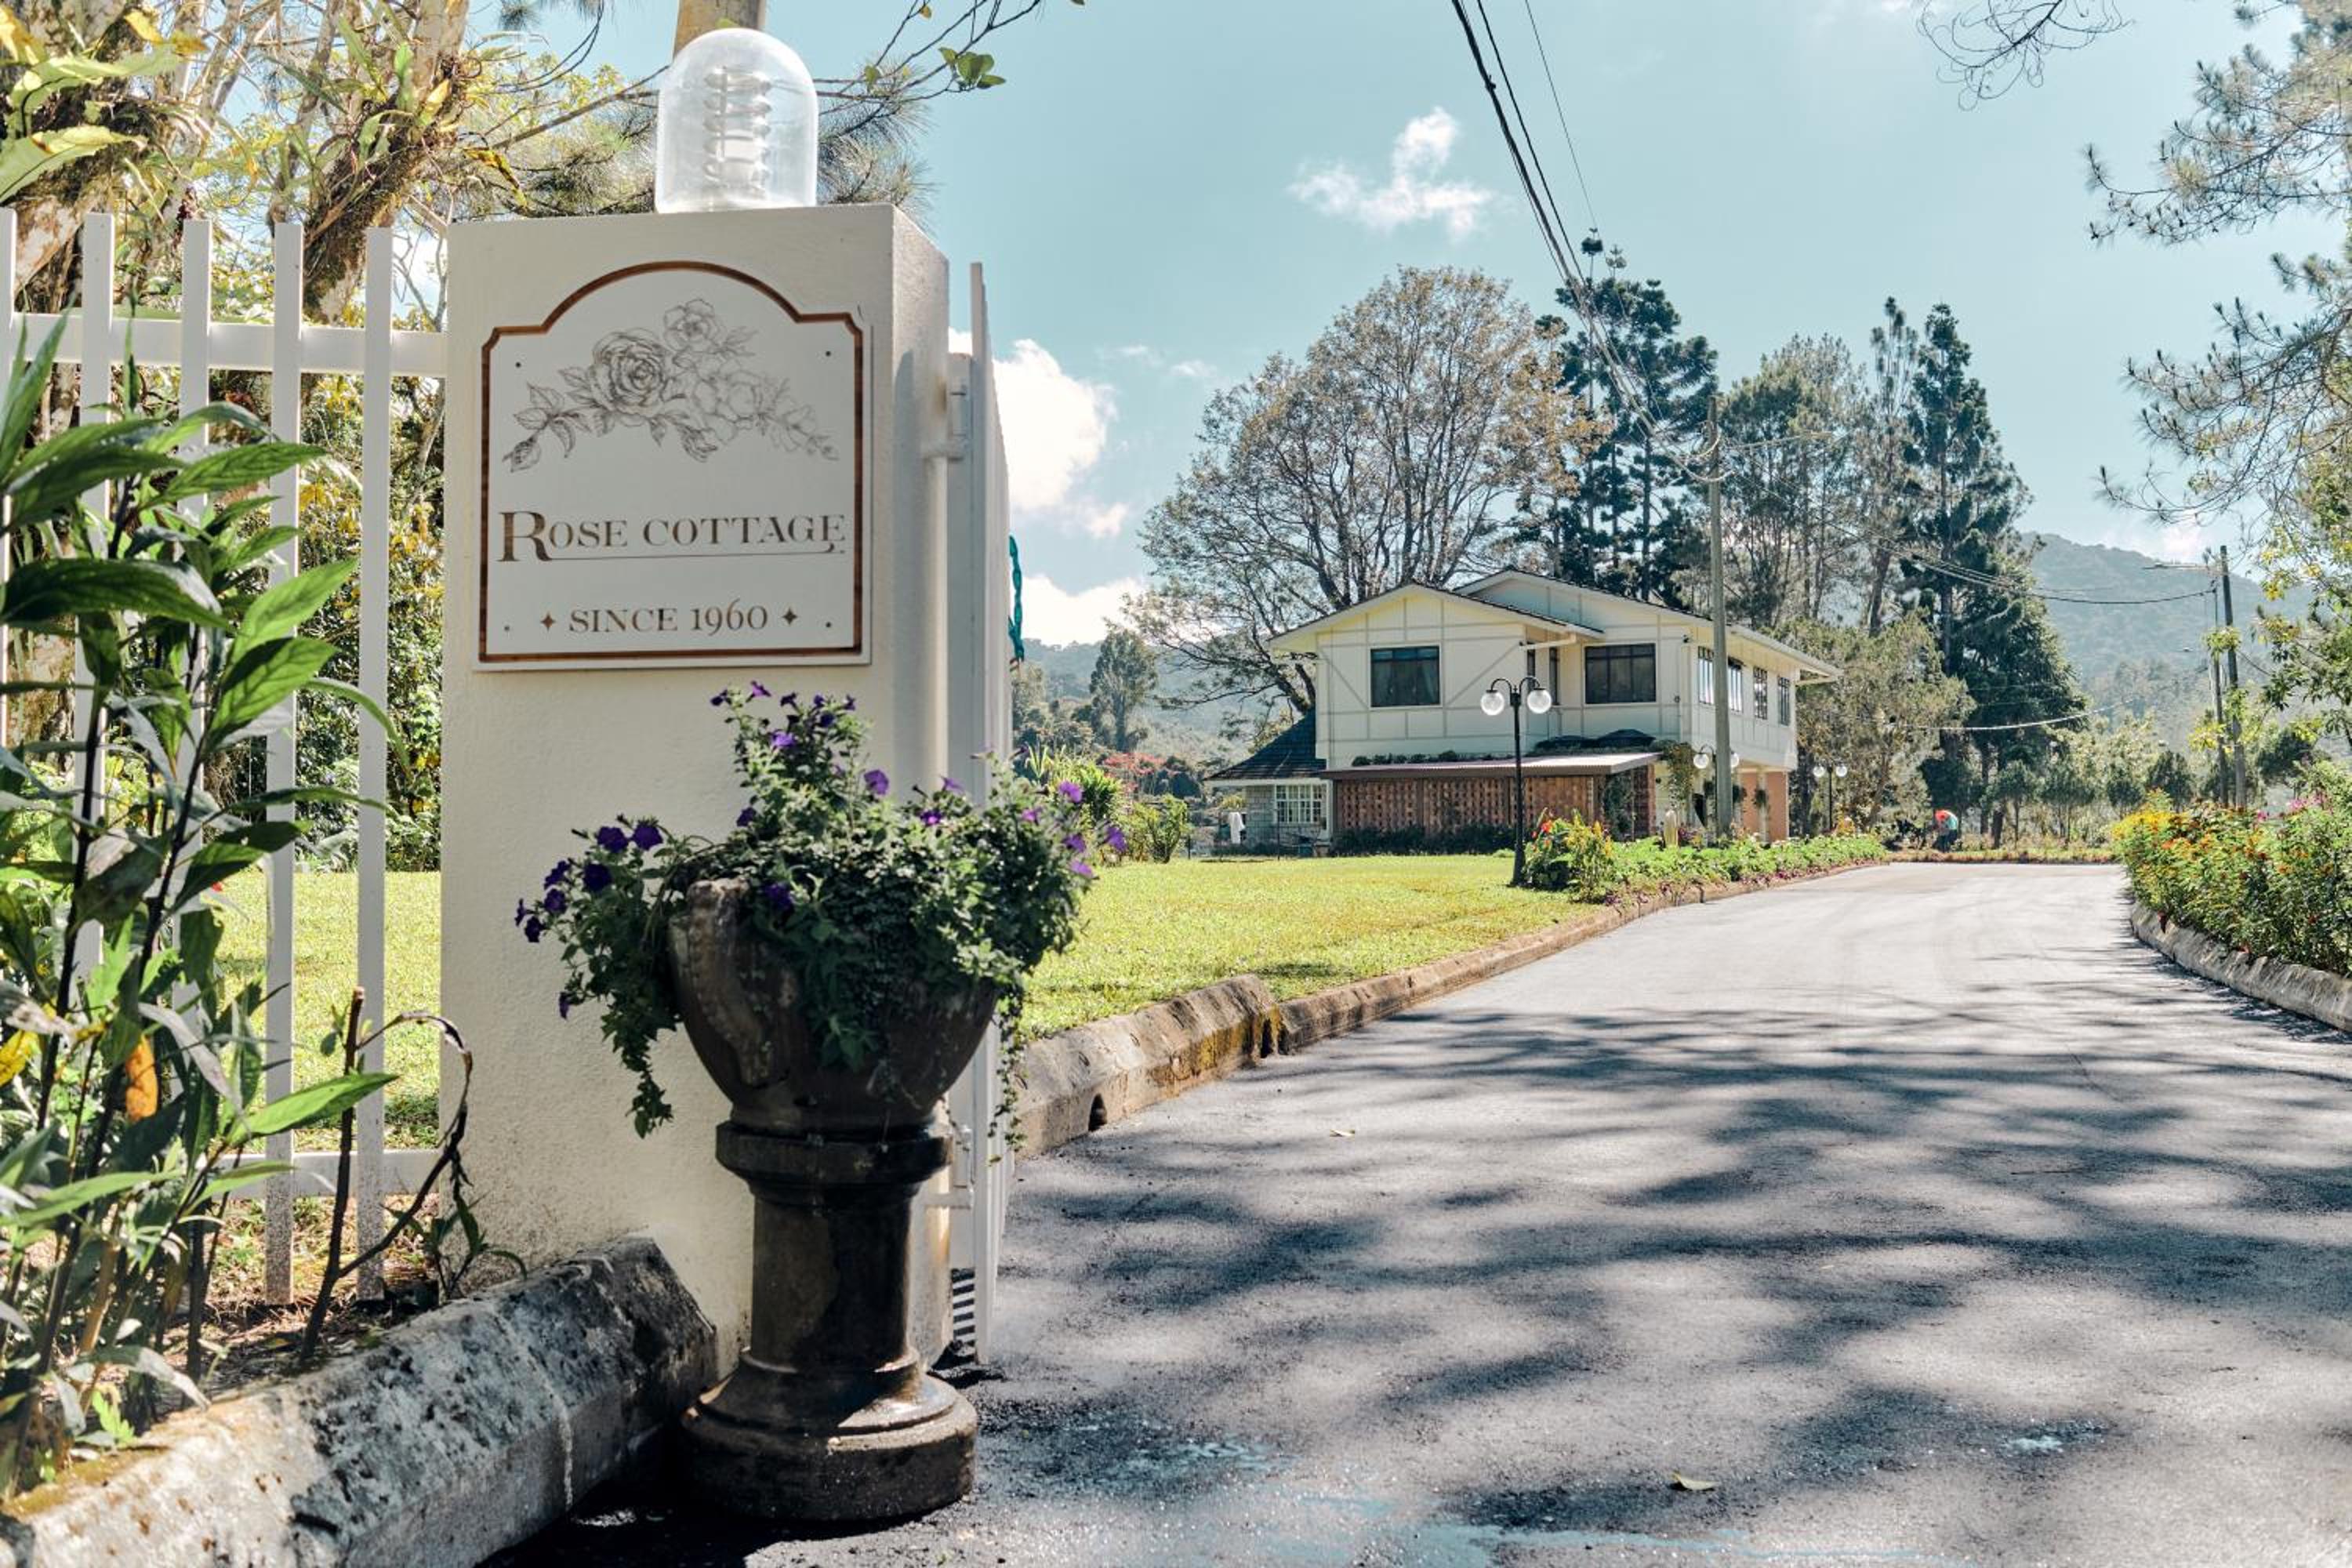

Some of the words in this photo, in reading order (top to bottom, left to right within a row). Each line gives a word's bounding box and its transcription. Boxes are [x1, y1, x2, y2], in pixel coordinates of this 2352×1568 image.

[496, 510, 629, 563] ROSE
[642, 514, 847, 547] COTTAGE
[568, 607, 679, 633] SINCE
[691, 598, 768, 637] 1960
